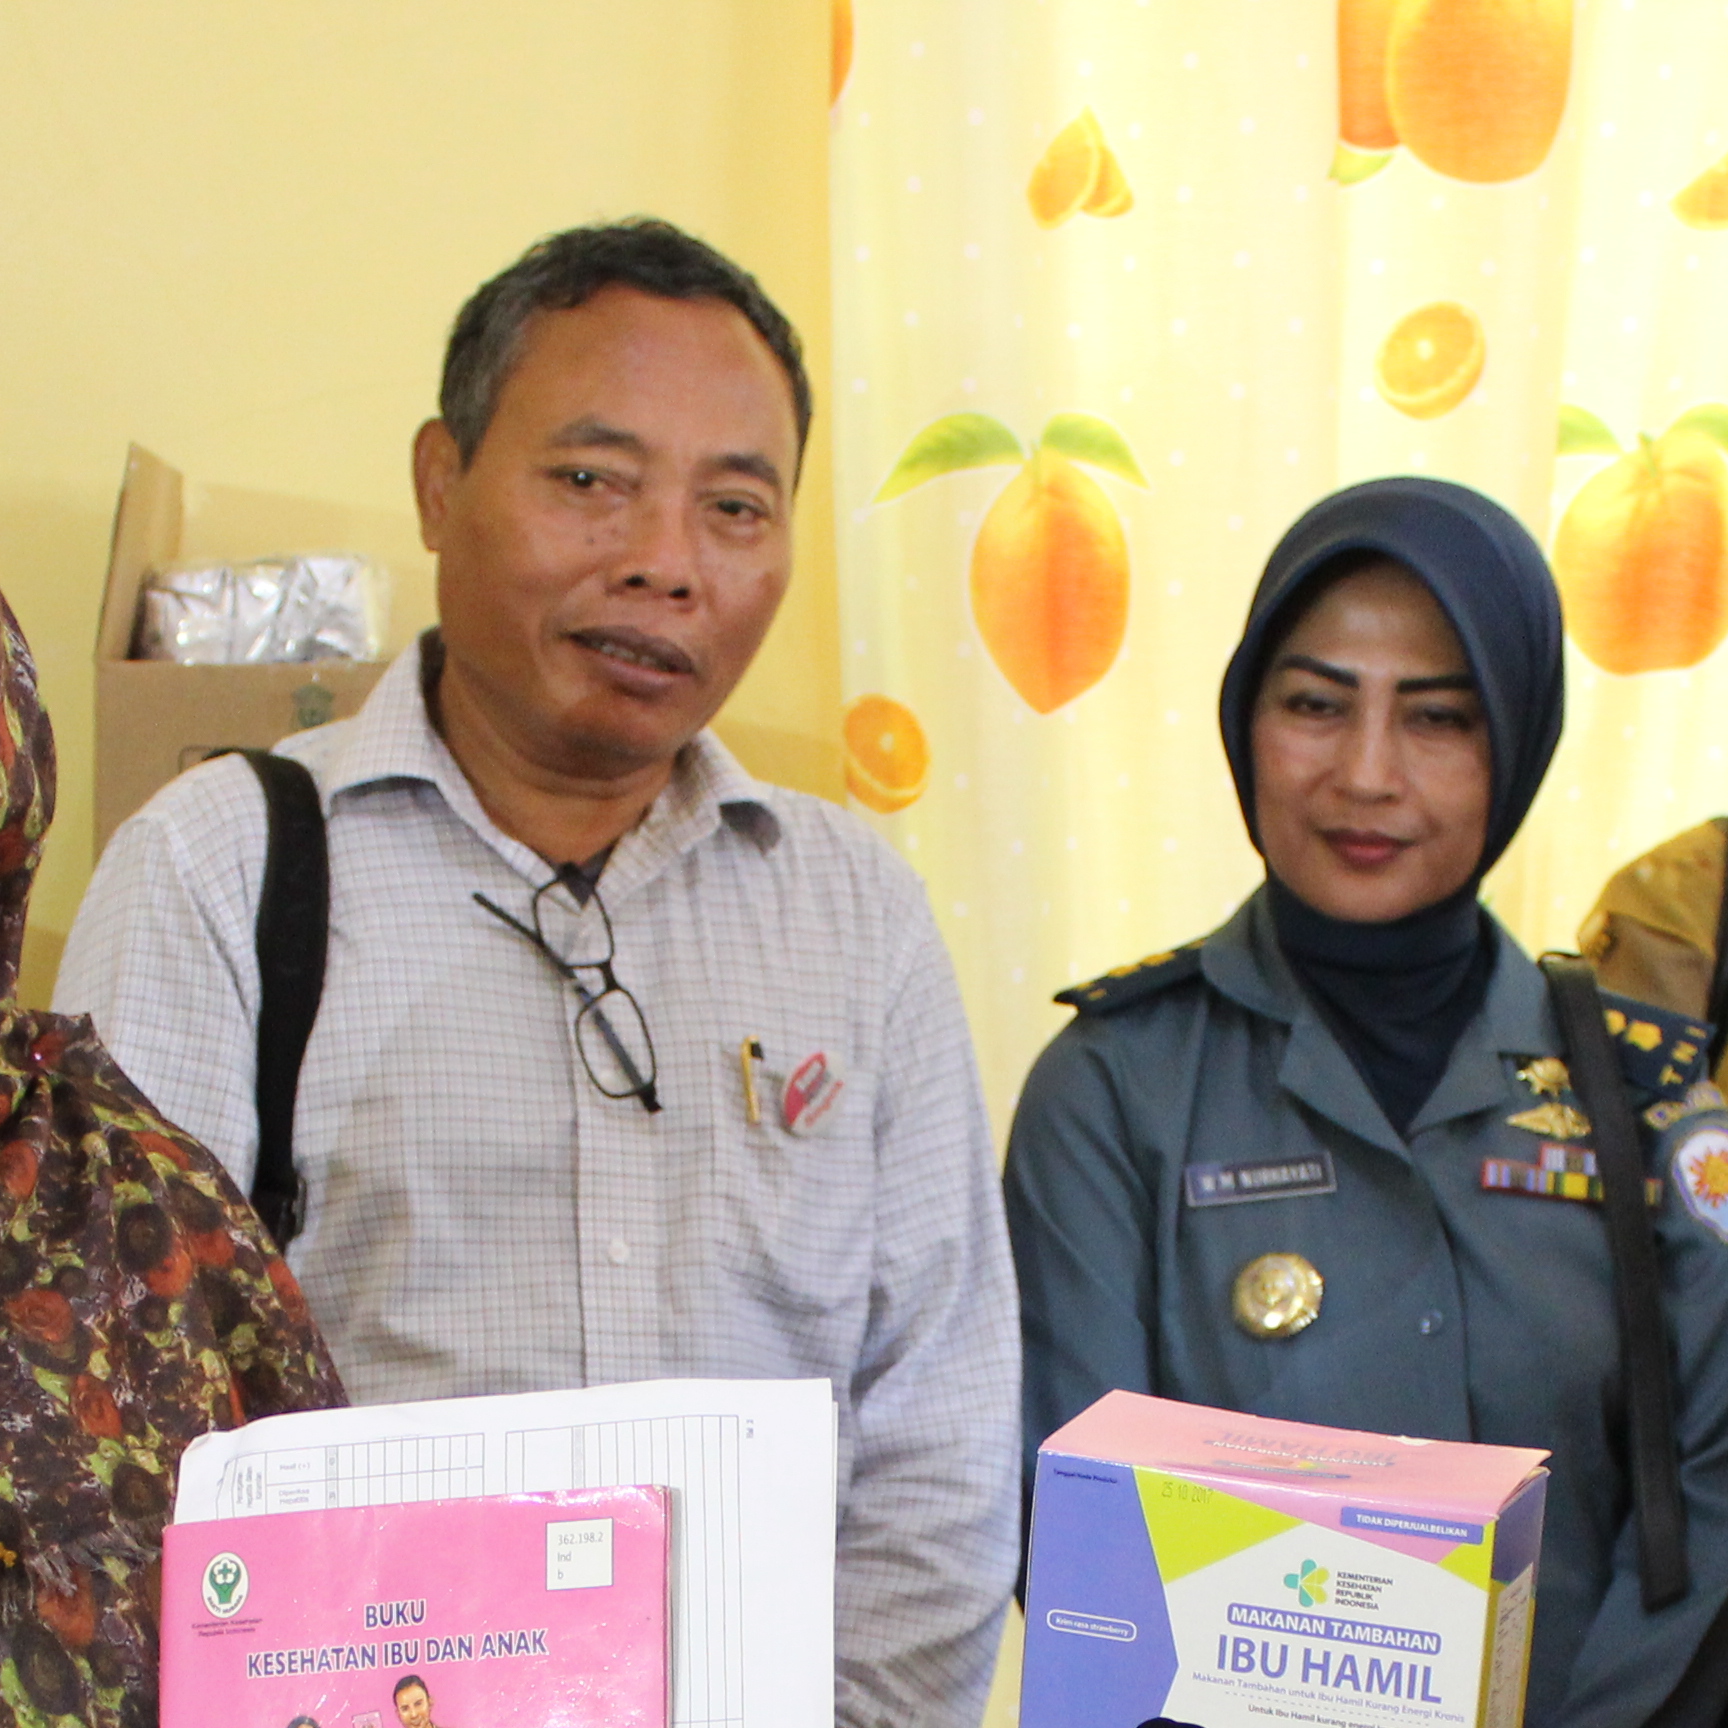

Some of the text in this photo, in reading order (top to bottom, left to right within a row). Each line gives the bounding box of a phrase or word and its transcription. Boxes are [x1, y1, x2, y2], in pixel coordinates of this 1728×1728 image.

[1356, 1513, 1468, 1538] TIDAK DIPERJUALBELIKAN
[557, 1531, 604, 1545] 362.198.2
[557, 1551, 572, 1562] Ind
[1336, 1580, 1382, 1594] KESEHATAN
[1337, 1570, 1393, 1586] KEMENTERIAN
[1334, 1597, 1379, 1611] INDONESIA
[1335, 1588, 1373, 1601] REPUBLIK
[365, 1600, 426, 1630] BUKU
[1232, 1606, 1438, 1652] MAKANAN TAMBAHAN
[247, 1629, 549, 1678] KESEHATAN IBU DAN ANAK
[1217, 1634, 1442, 1705] IBU HAMIL
[1193, 1671, 1465, 1724] Makanan Tambahan untuk Ibu Hamil Kurang Energi Kronis
[1248, 1704, 1274, 1717] Untuk
[1276, 1707, 1289, 1719] Ibu
[1291, 1710, 1315, 1723] Hamil
